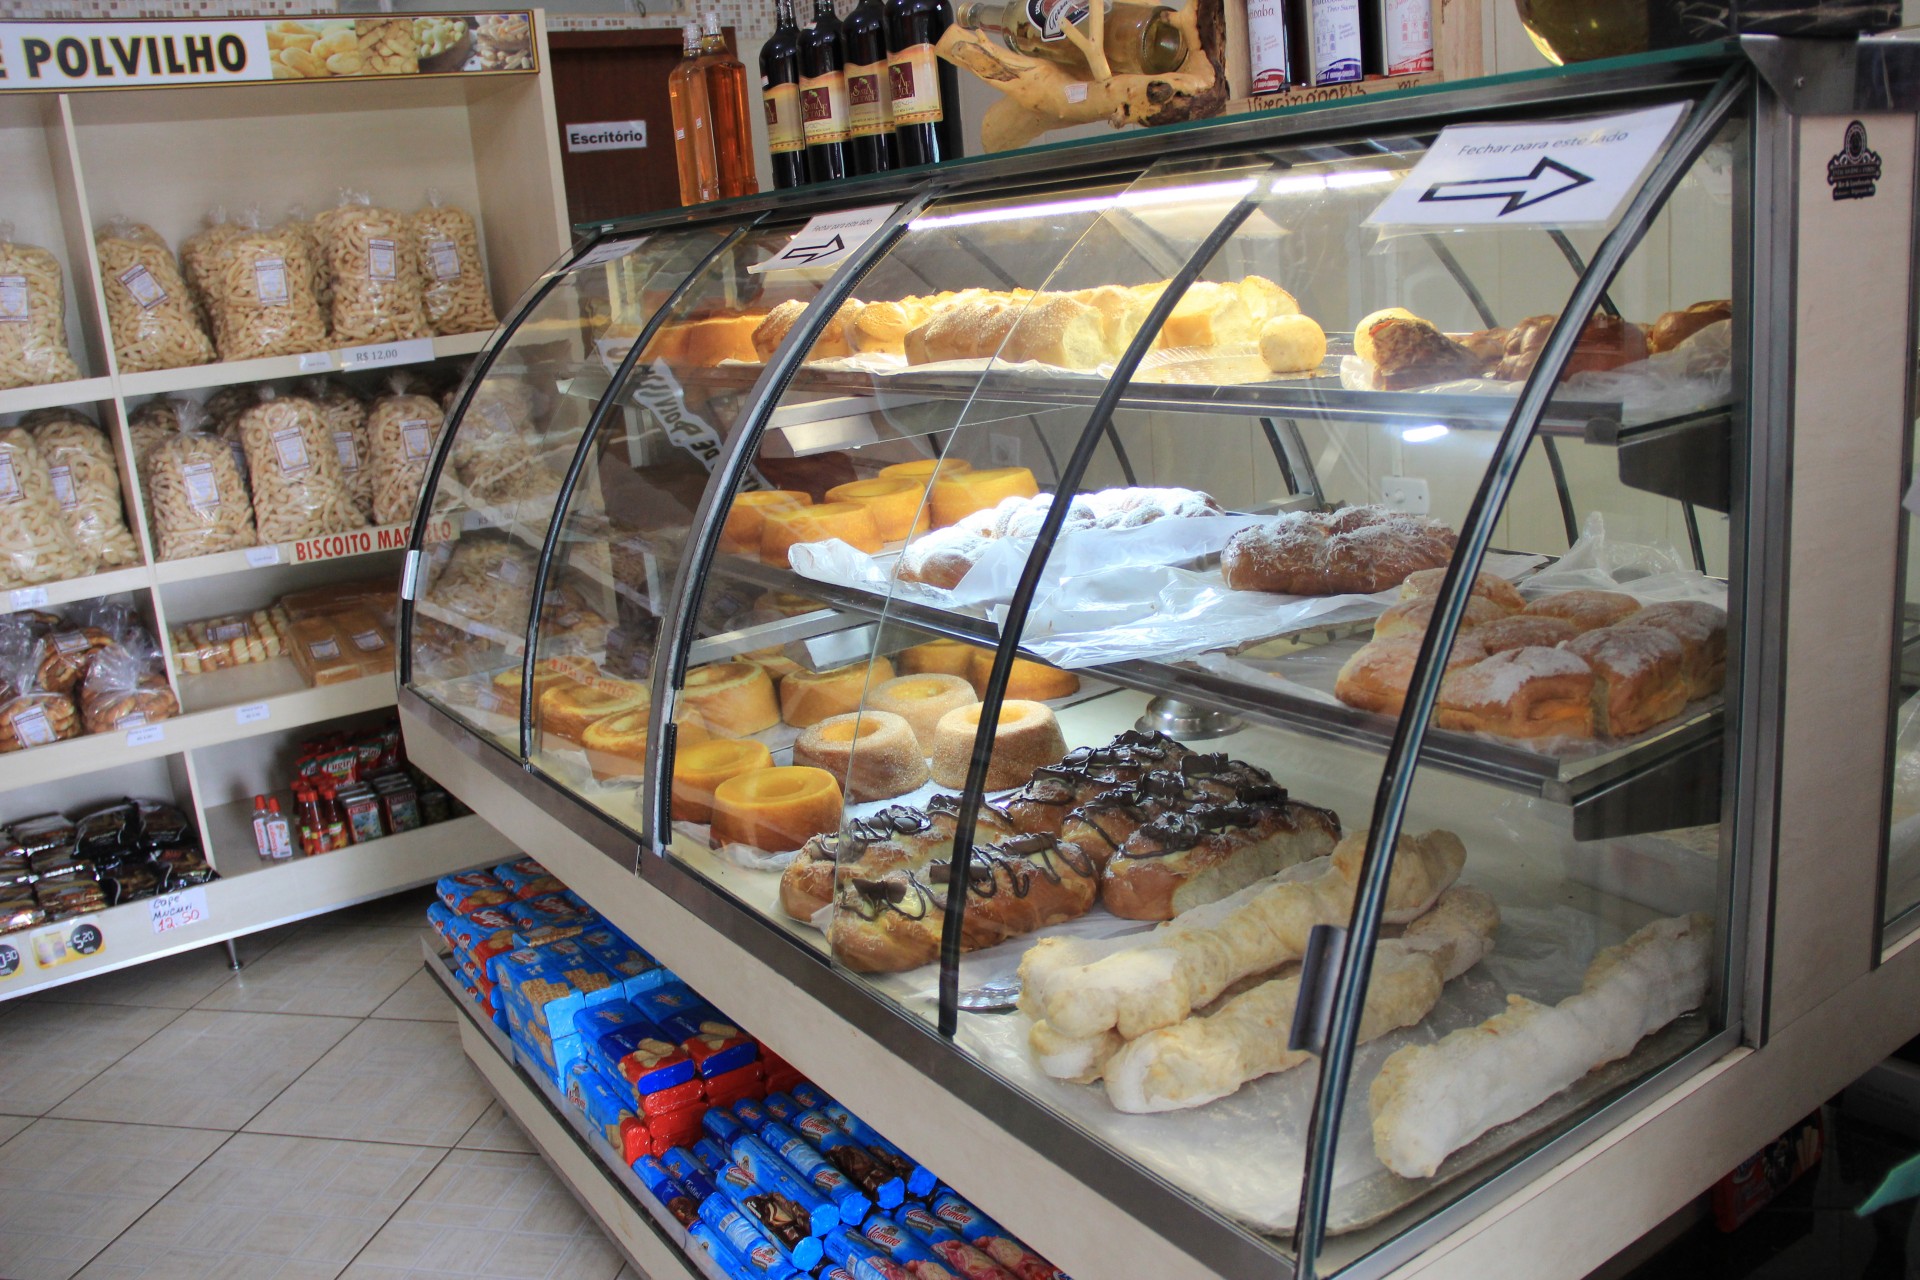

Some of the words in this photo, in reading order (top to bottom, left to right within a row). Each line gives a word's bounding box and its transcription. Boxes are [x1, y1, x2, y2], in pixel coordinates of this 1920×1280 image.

[21, 33, 247, 78] POLVILHO
[570, 130, 643, 146] Escritório
[1458, 143, 1512, 156] Fechar
[1511, 141, 1549, 154] para
[1552, 137, 1588, 148] este
[1590, 131, 1629, 145] lado
[356, 352, 369, 362] R$
[372, 349, 398, 361] 12,00
[295, 532, 372, 562] BISCOITO
